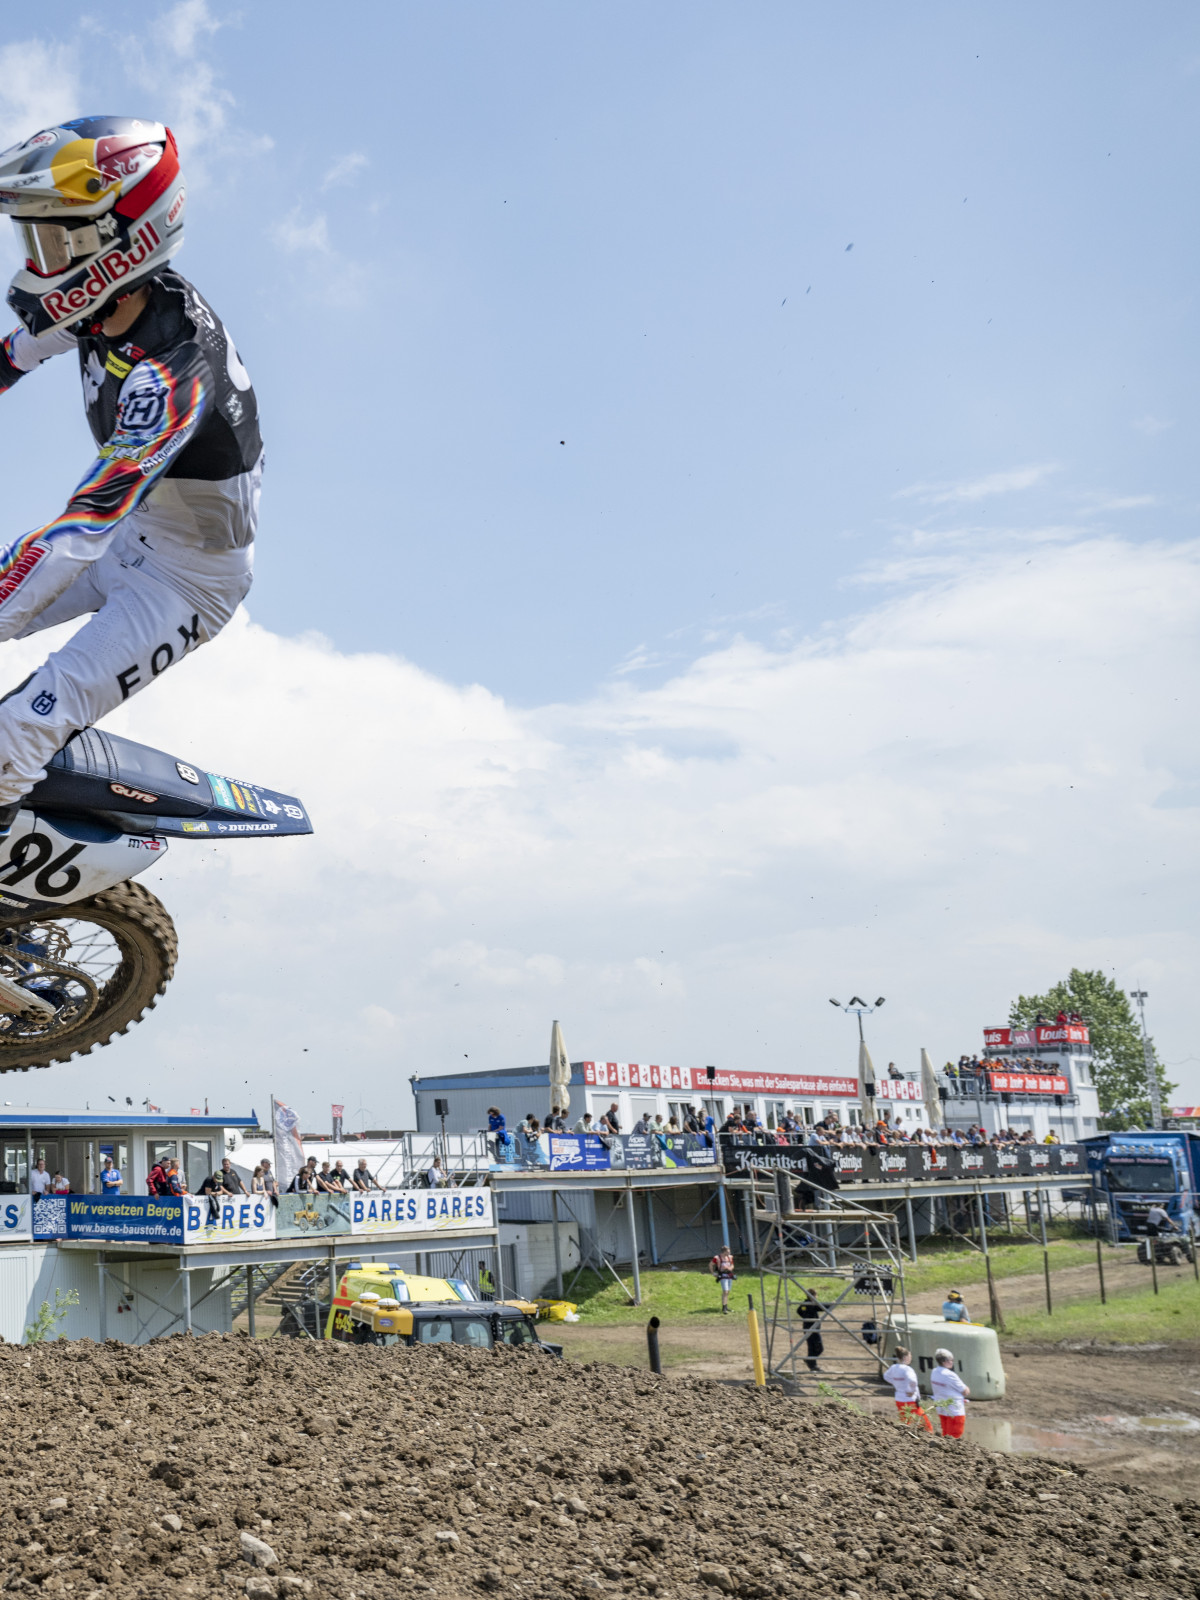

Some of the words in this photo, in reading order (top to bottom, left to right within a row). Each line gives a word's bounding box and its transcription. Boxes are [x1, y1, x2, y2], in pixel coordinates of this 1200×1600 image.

[41, 263, 109, 323] Red
[102, 220, 161, 283] Bull
[116, 612, 200, 701] FOX
[110, 783, 159, 804] GUTS
[228, 823, 278, 832] DUNLOP
[1040, 1027, 1069, 1041] Louis
[696, 1072, 730, 1086] Entecken
[70, 1202, 88, 1215] Wir
[91, 1203, 144, 1216] versetzen
[146, 1203, 181, 1220] Berge
[187, 1203, 265, 1231] BARES
[353, 1198, 417, 1223] BARES
[426, 1195, 485, 1220] BARES
[71, 1222, 183, 1237] www.bares-baustoffe.de
